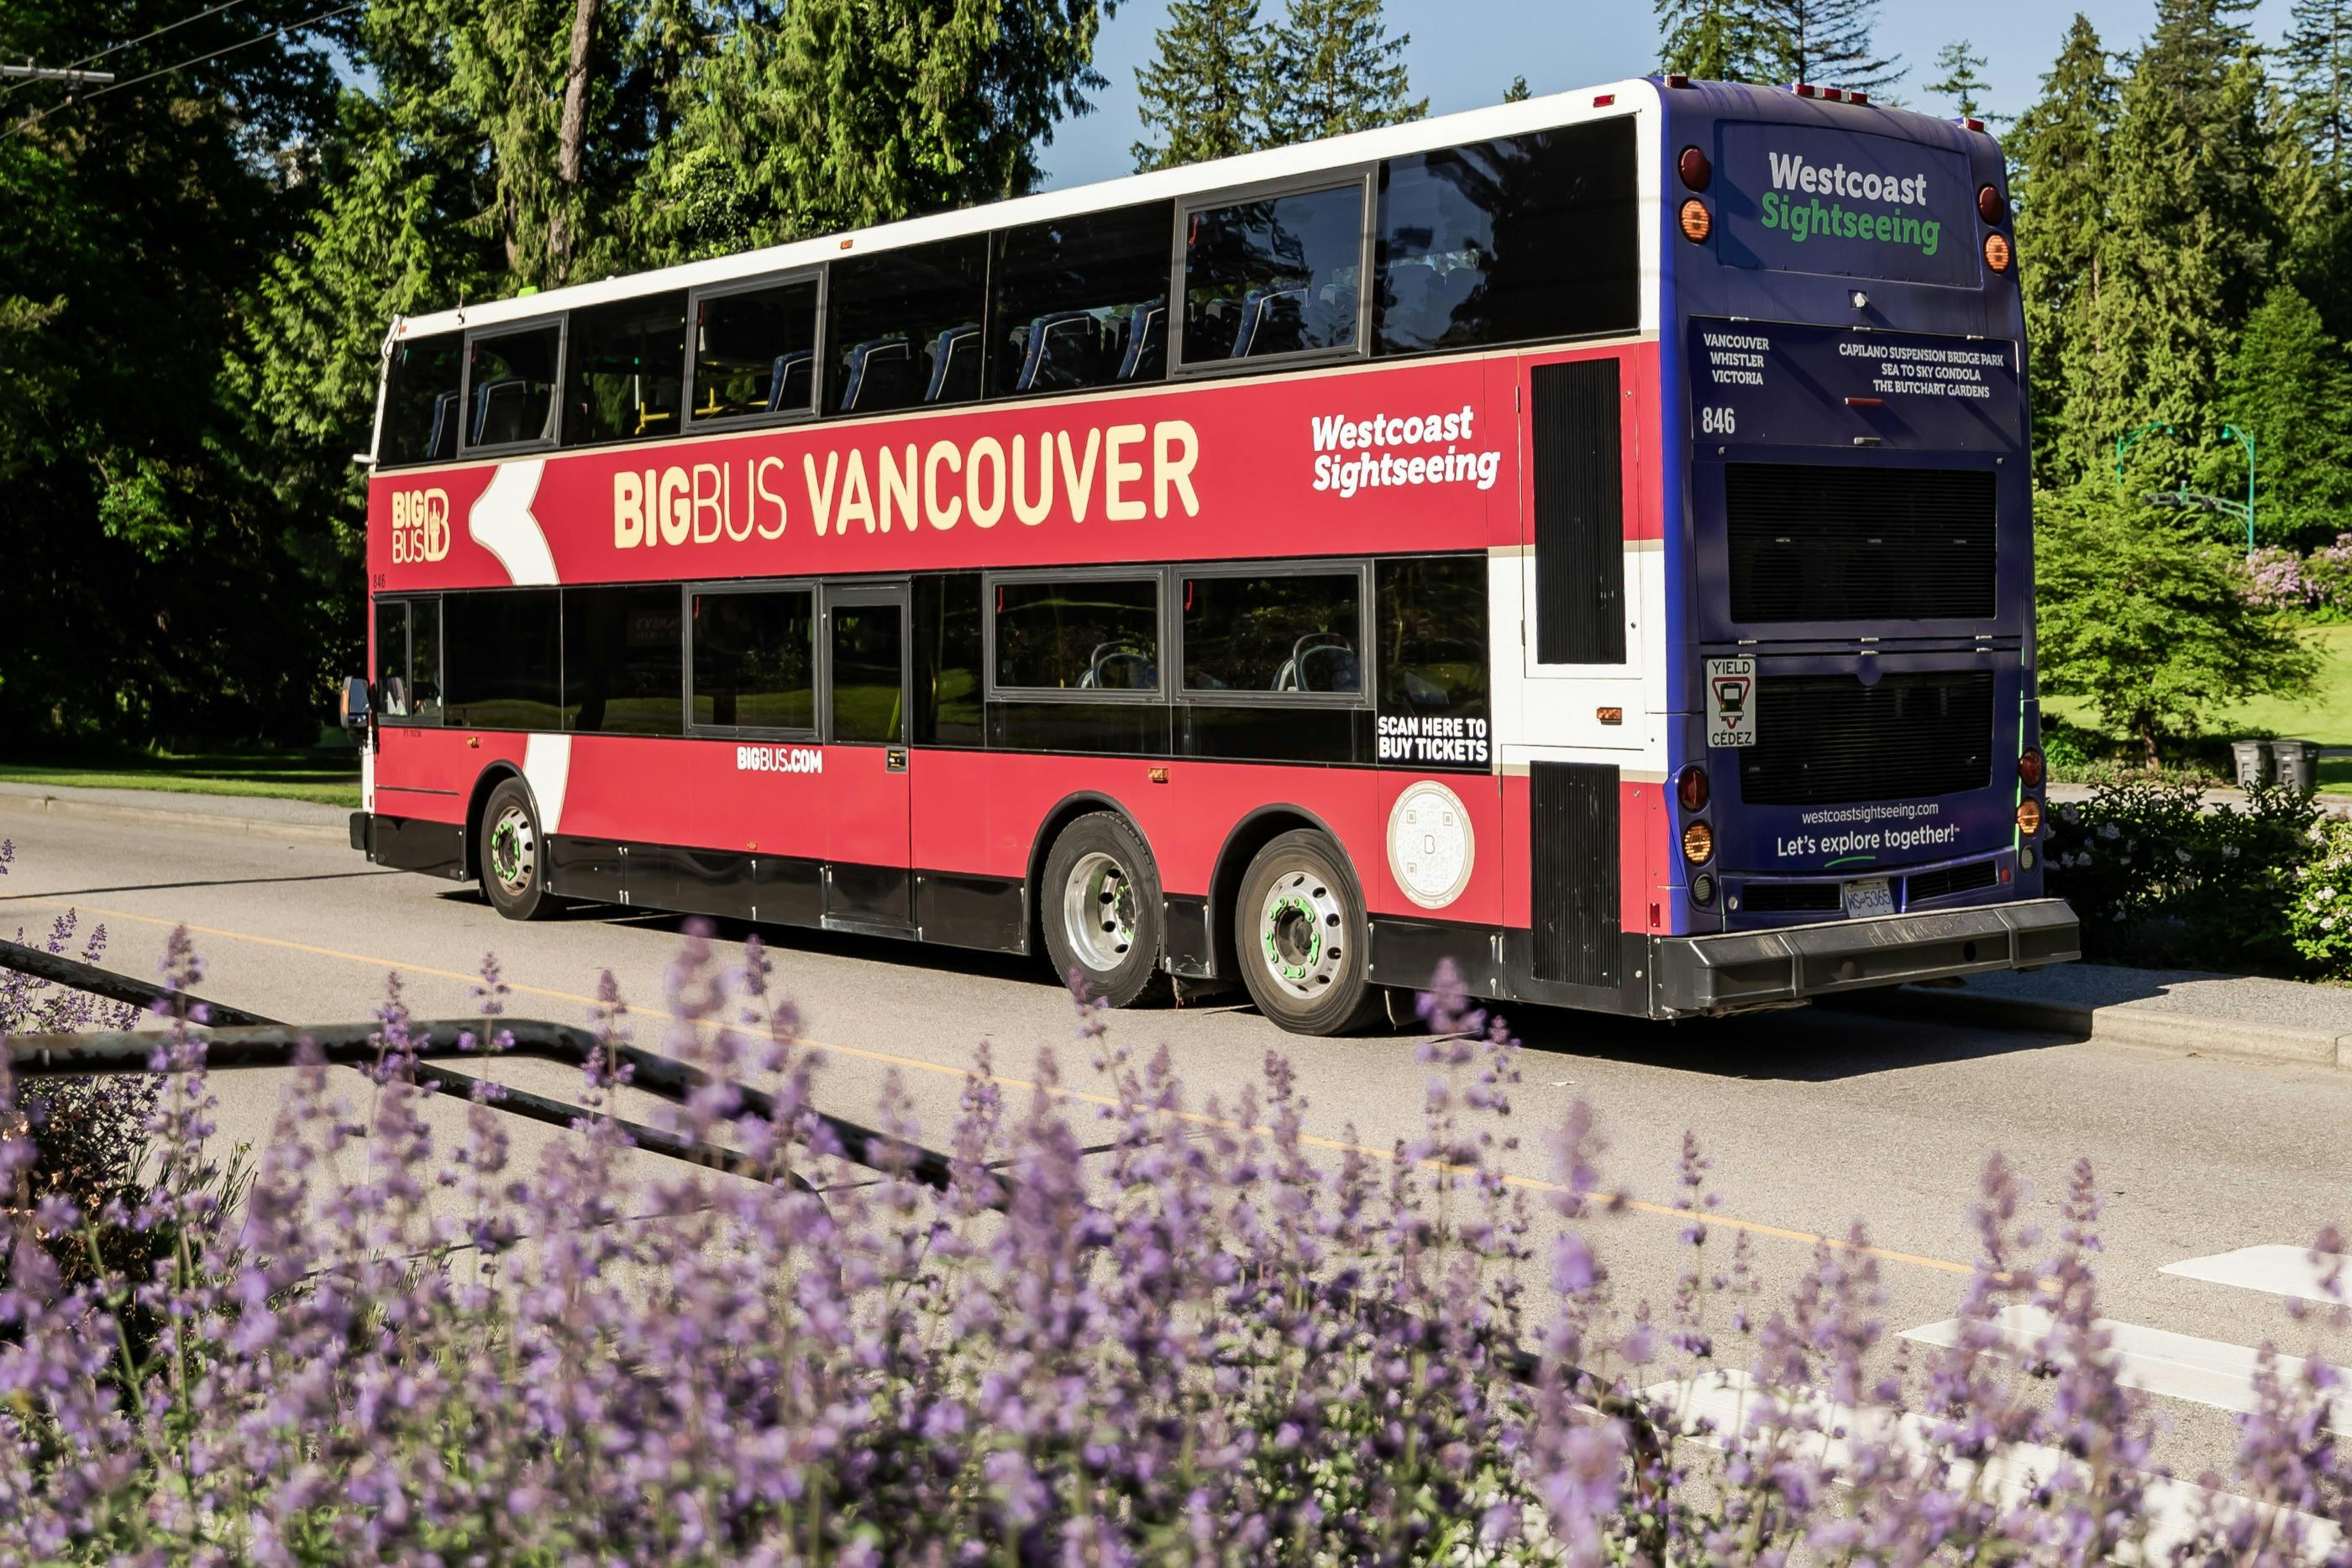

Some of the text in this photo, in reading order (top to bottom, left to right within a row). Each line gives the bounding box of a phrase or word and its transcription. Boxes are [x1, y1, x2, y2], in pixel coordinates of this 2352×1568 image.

[1769, 152, 1927, 206] Westcoast
[1761, 191, 1940, 255] Sightseeing
[1703, 333, 1769, 350] VANCOUVER
[1710, 351, 1764, 367] WHISTLER
[1839, 343, 2004, 366] CAPILANO SUSPENSION BRIDGE PARK
[1712, 370, 1764, 385] VICTORIA
[1882, 363, 1982, 380] SEA TO SKY GONDOLA
[1873, 380, 1990, 397] THE BUTCHART GARDENS
[1311, 405, 1474, 452] Westcoast
[1702, 406, 1735, 434] 846
[803, 420, 1200, 537] VANCOUVER
[1312, 445, 1501, 498] Sightseeing
[391, 490, 424, 529] BIG
[392, 528, 424, 564] BUS
[373, 574, 386, 589] 846
[1712, 661, 1751, 674] YIELD
[1378, 716, 1487, 738] SCAN HERE TO
[1712, 730, 1752, 746] CÉDEZ
[737, 747, 822, 774] BIGBUS.COM
[1378, 737, 1488, 762] BUY TICKETS
[1802, 803, 1939, 824] westcoastsightseeing.com
[1777, 835, 1816, 857] Let's
[1820, 831, 1880, 855] explore
